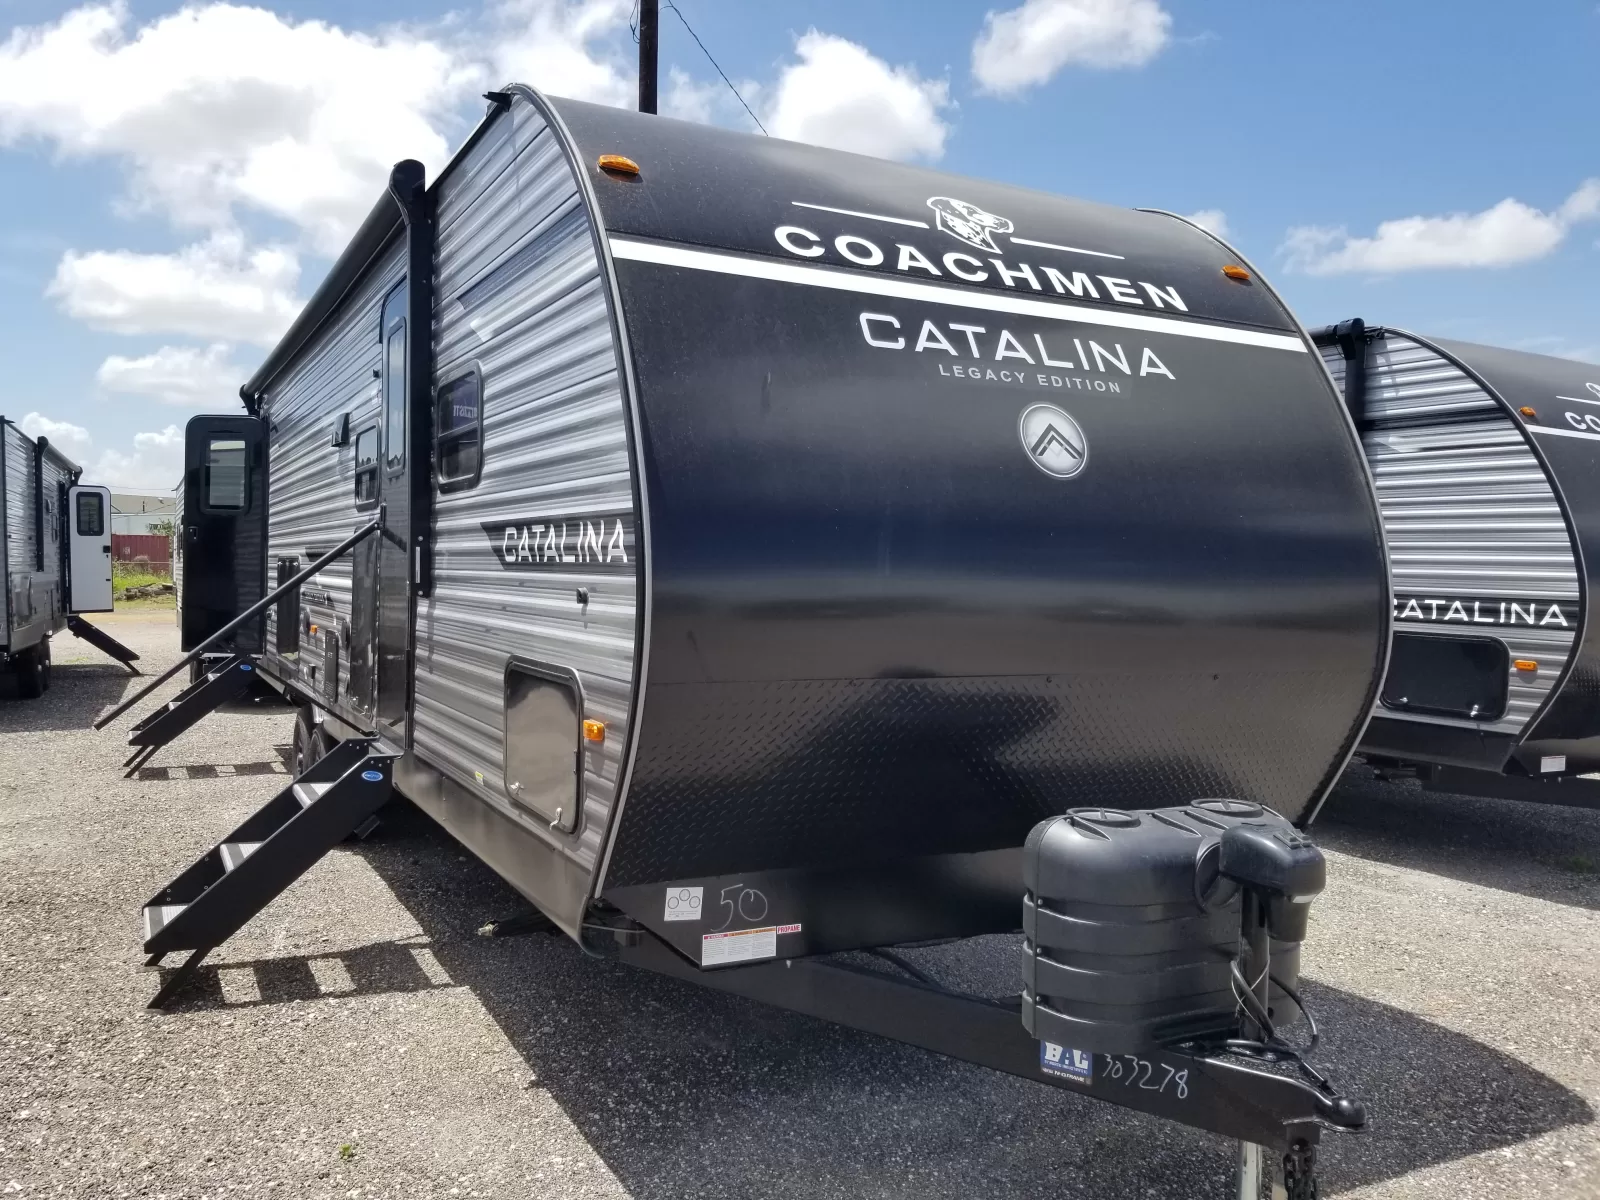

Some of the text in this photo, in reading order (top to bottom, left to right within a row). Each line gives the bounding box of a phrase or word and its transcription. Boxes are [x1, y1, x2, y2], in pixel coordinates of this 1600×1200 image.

[774, 225, 1189, 312] COACHMEN
[859, 312, 1176, 381] CATALINA
[938, 363, 1121, 394] LEGACY EDITION
[503, 518, 628, 563] CATALINA
[1393, 598, 1568, 627] ATALINA
[710, 883, 768, 932] 50
[777, 924, 801, 934] PROPANE
[1101, 1053, 1189, 1099] 303278
